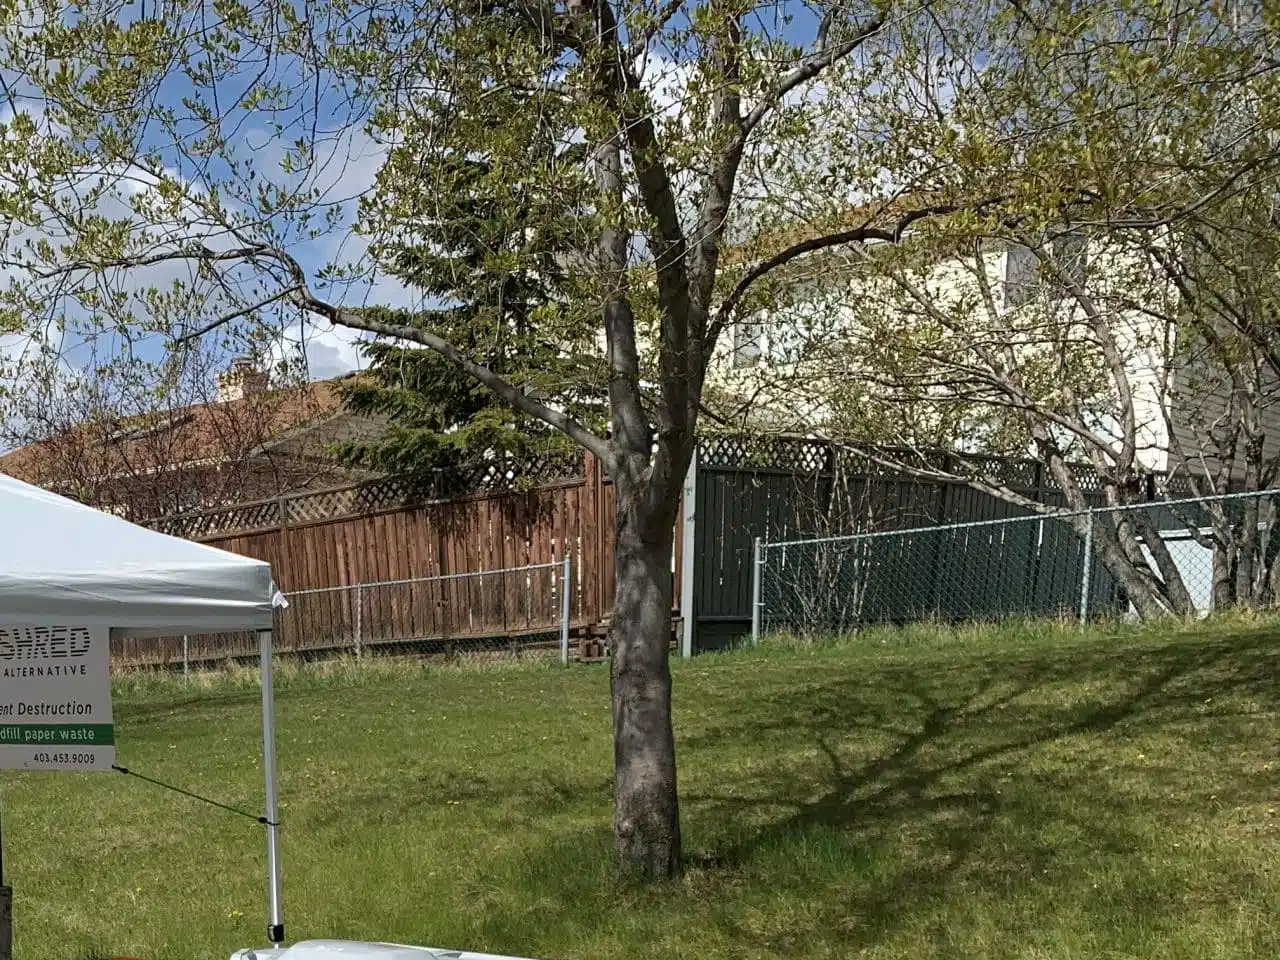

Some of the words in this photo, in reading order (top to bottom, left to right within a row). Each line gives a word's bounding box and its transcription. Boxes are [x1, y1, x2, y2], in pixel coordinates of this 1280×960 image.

[4, 664, 87, 678] ALTERNATIVE
[18, 700, 92, 716] Destruction
[24, 729, 56, 742] paper
[58, 727, 96, 740] waste
[33, 753, 96, 764] 403.453.9009
